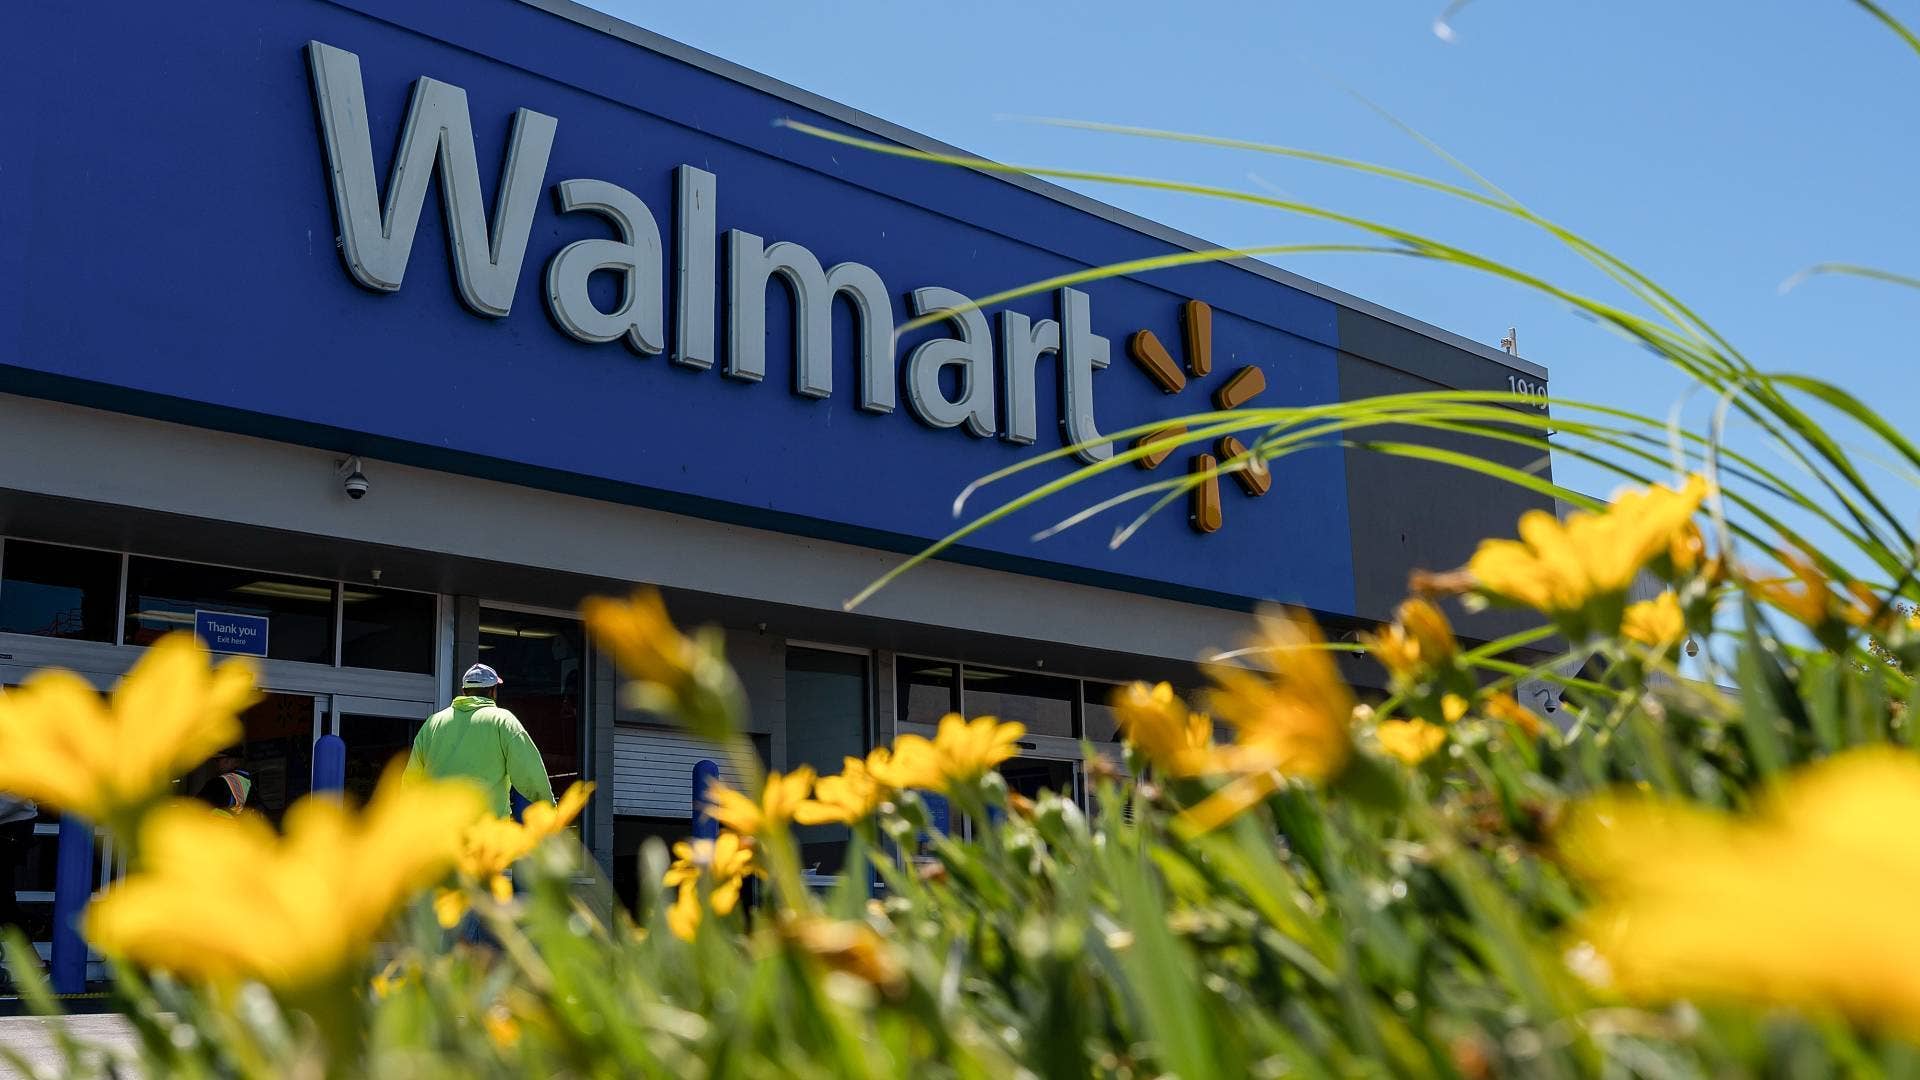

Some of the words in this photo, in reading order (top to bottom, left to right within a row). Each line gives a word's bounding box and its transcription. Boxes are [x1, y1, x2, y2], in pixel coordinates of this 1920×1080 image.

[304, 39, 1114, 465] Walmart
[1508, 375, 1548, 409] 1919
[207, 621, 237, 634] Thank
[238, 627, 257, 637] you
[217, 635, 230, 643] Exit
[231, 637, 246, 645] here
